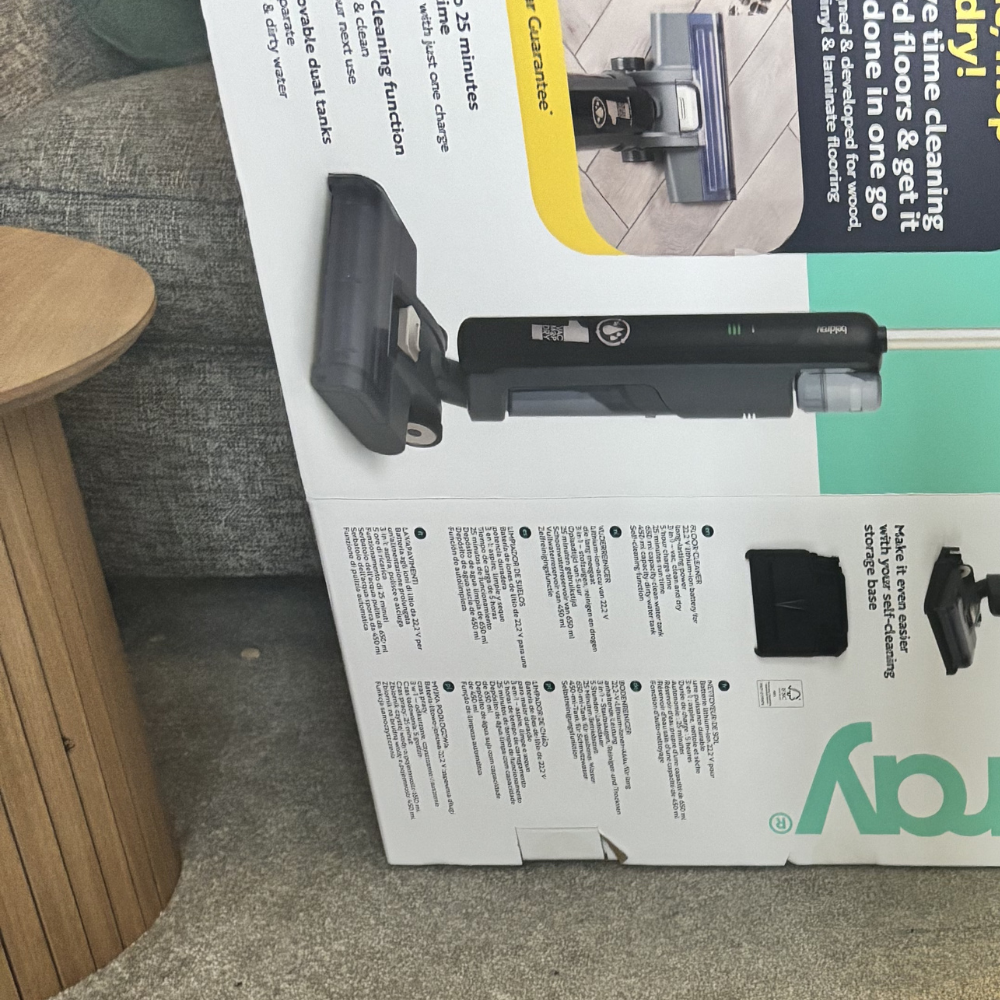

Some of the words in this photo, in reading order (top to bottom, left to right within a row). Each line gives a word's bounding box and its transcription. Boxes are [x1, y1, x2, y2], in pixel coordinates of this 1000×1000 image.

[262, 3, 274, 14] &
[353, 2, 365, 13] &
[420, 3, 433, 37] with
[455, 12, 471, 32] 25
[892, 0, 916, 23] d
[265, 18, 279, 53] dirty
[338, 21, 353, 55] next
[356, 17, 370, 57] clean
[821, 37, 835, 51] &
[840, 38, 853, 53] &
[863, 0, 885, 79] done
[948, 0, 987, 77] dry!
[345, 59, 357, 84] use
[421, 40, 438, 69] just
[922, 28, 945, 101] time
[273, 57, 288, 99] water
[308, 58, 326, 96] dual
[370, 0, 391, 77] cleaning
[384, 81, 405, 156] function
[430, 72, 441, 100] one
[459, 37, 479, 111] minutes
[893, 30, 916, 121] floors
[823, 55, 837, 132] laminate
[841, 56, 858, 149] developed
[866, 87, 888, 115] in
[315, 99, 332, 144] tanks
[434, 104, 449, 153] charge
[868, 123, 886, 179] one
[897, 128, 919, 152] &
[827, 136, 842, 202] flooring
[846, 153, 859, 178] for
[892, 158, 919, 204] get
[922, 108, 948, 231] cleaning
[865, 186, 887, 221] go
[900, 212, 920, 232] it
[863, 524, 875, 576] storage
[879, 524, 892, 555] with
[894, 525, 906, 562] Make
[878, 558, 890, 591] your
[896, 565, 908, 576] it
[867, 579, 879, 610] base
[897, 579, 906, 611] even
[883, 593, 897, 679] self-cleaning
[898, 614, 911, 653] easier
